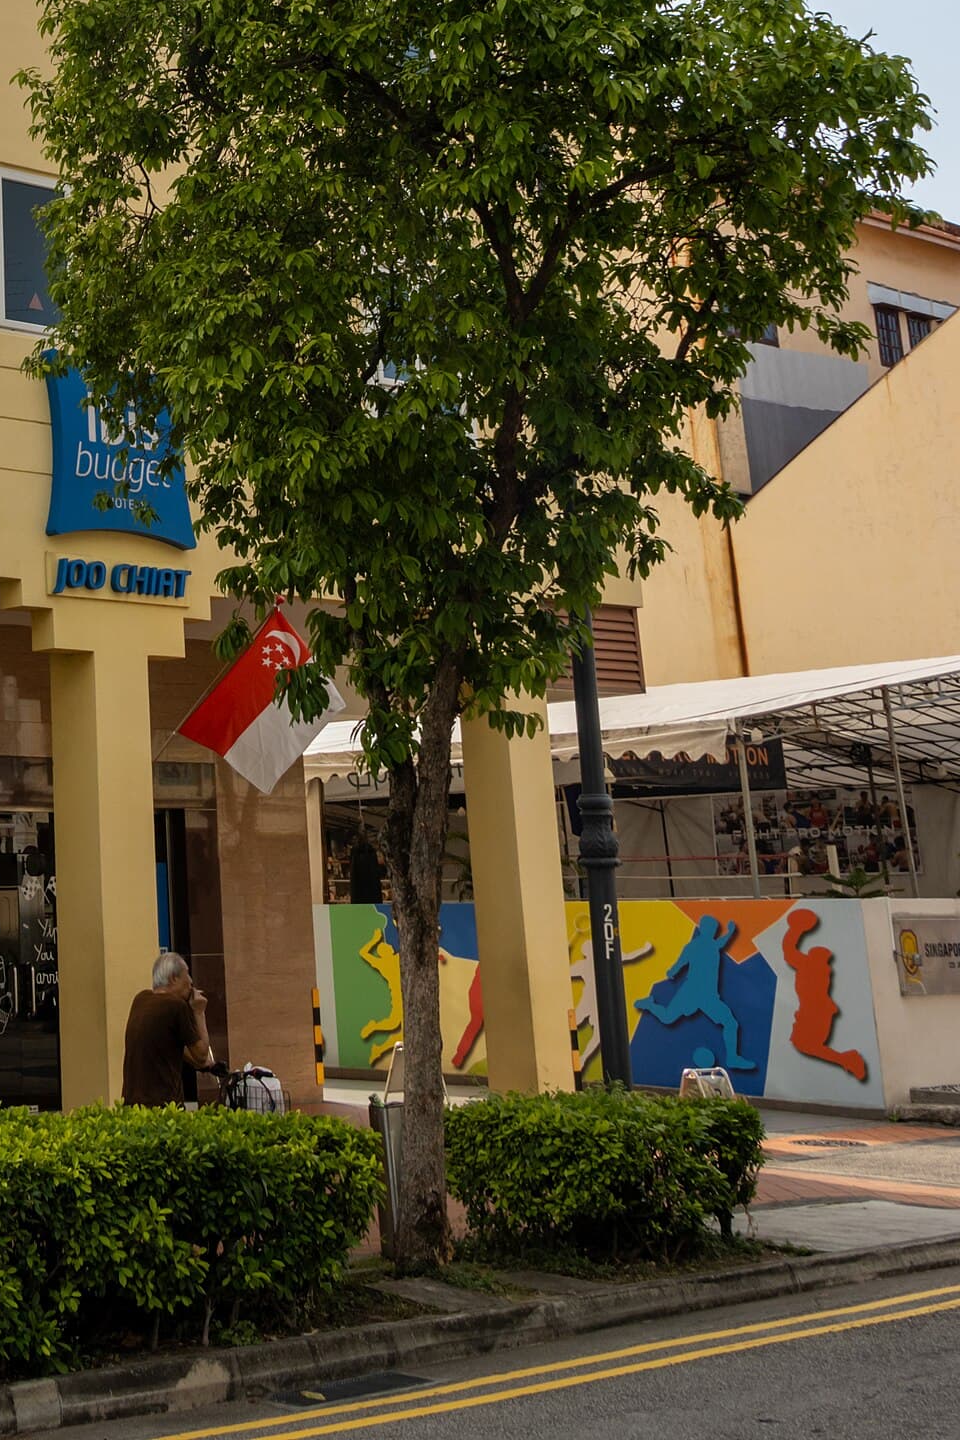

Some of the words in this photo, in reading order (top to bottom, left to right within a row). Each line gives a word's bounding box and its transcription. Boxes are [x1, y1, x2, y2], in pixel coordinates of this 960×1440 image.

[53, 558, 107, 594] JOO
[111, 563, 192, 599] CHIAT
[732, 828, 780, 842] FIHT
[33, 943, 54, 962] You
